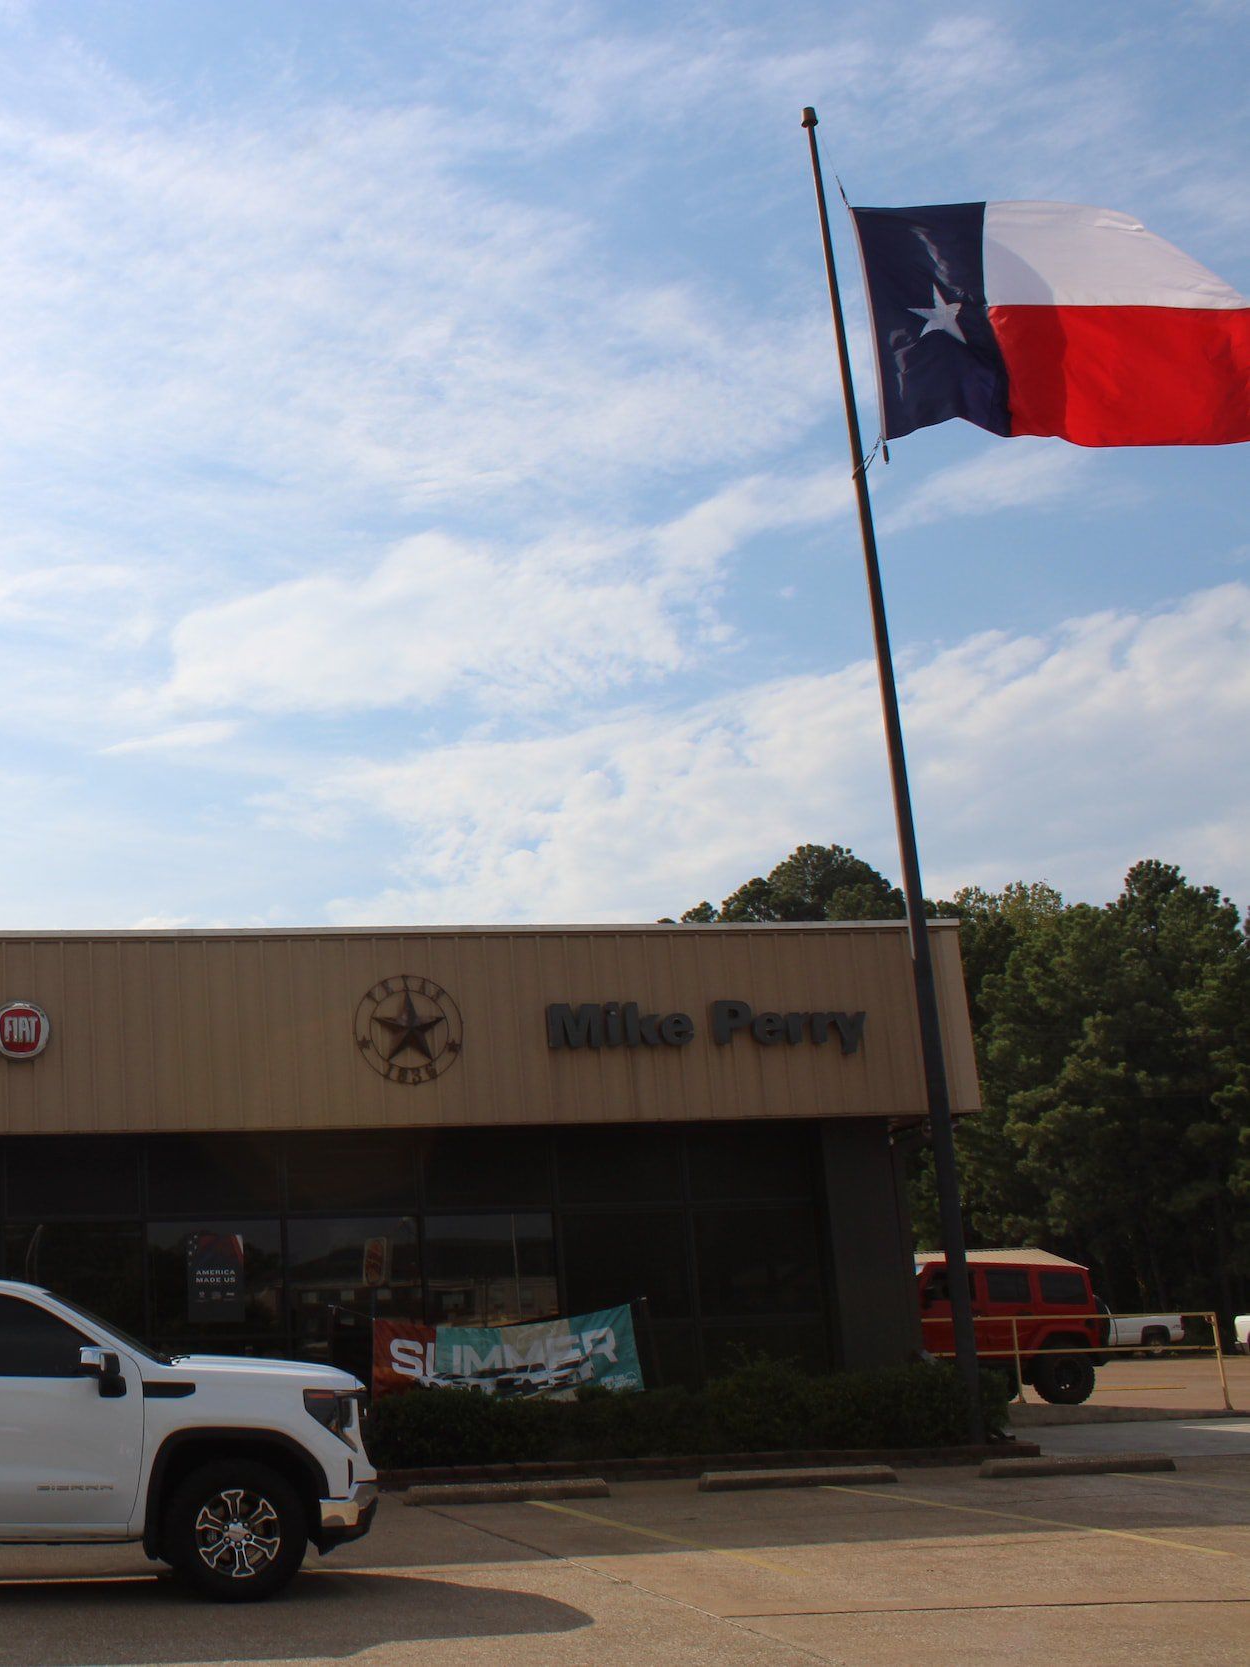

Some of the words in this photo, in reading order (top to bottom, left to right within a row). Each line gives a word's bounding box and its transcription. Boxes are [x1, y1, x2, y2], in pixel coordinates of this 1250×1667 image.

[4, 1016, 38, 1043] FIAT
[546, 1001, 694, 1050] Mike
[711, 1000, 866, 1055] Perry
